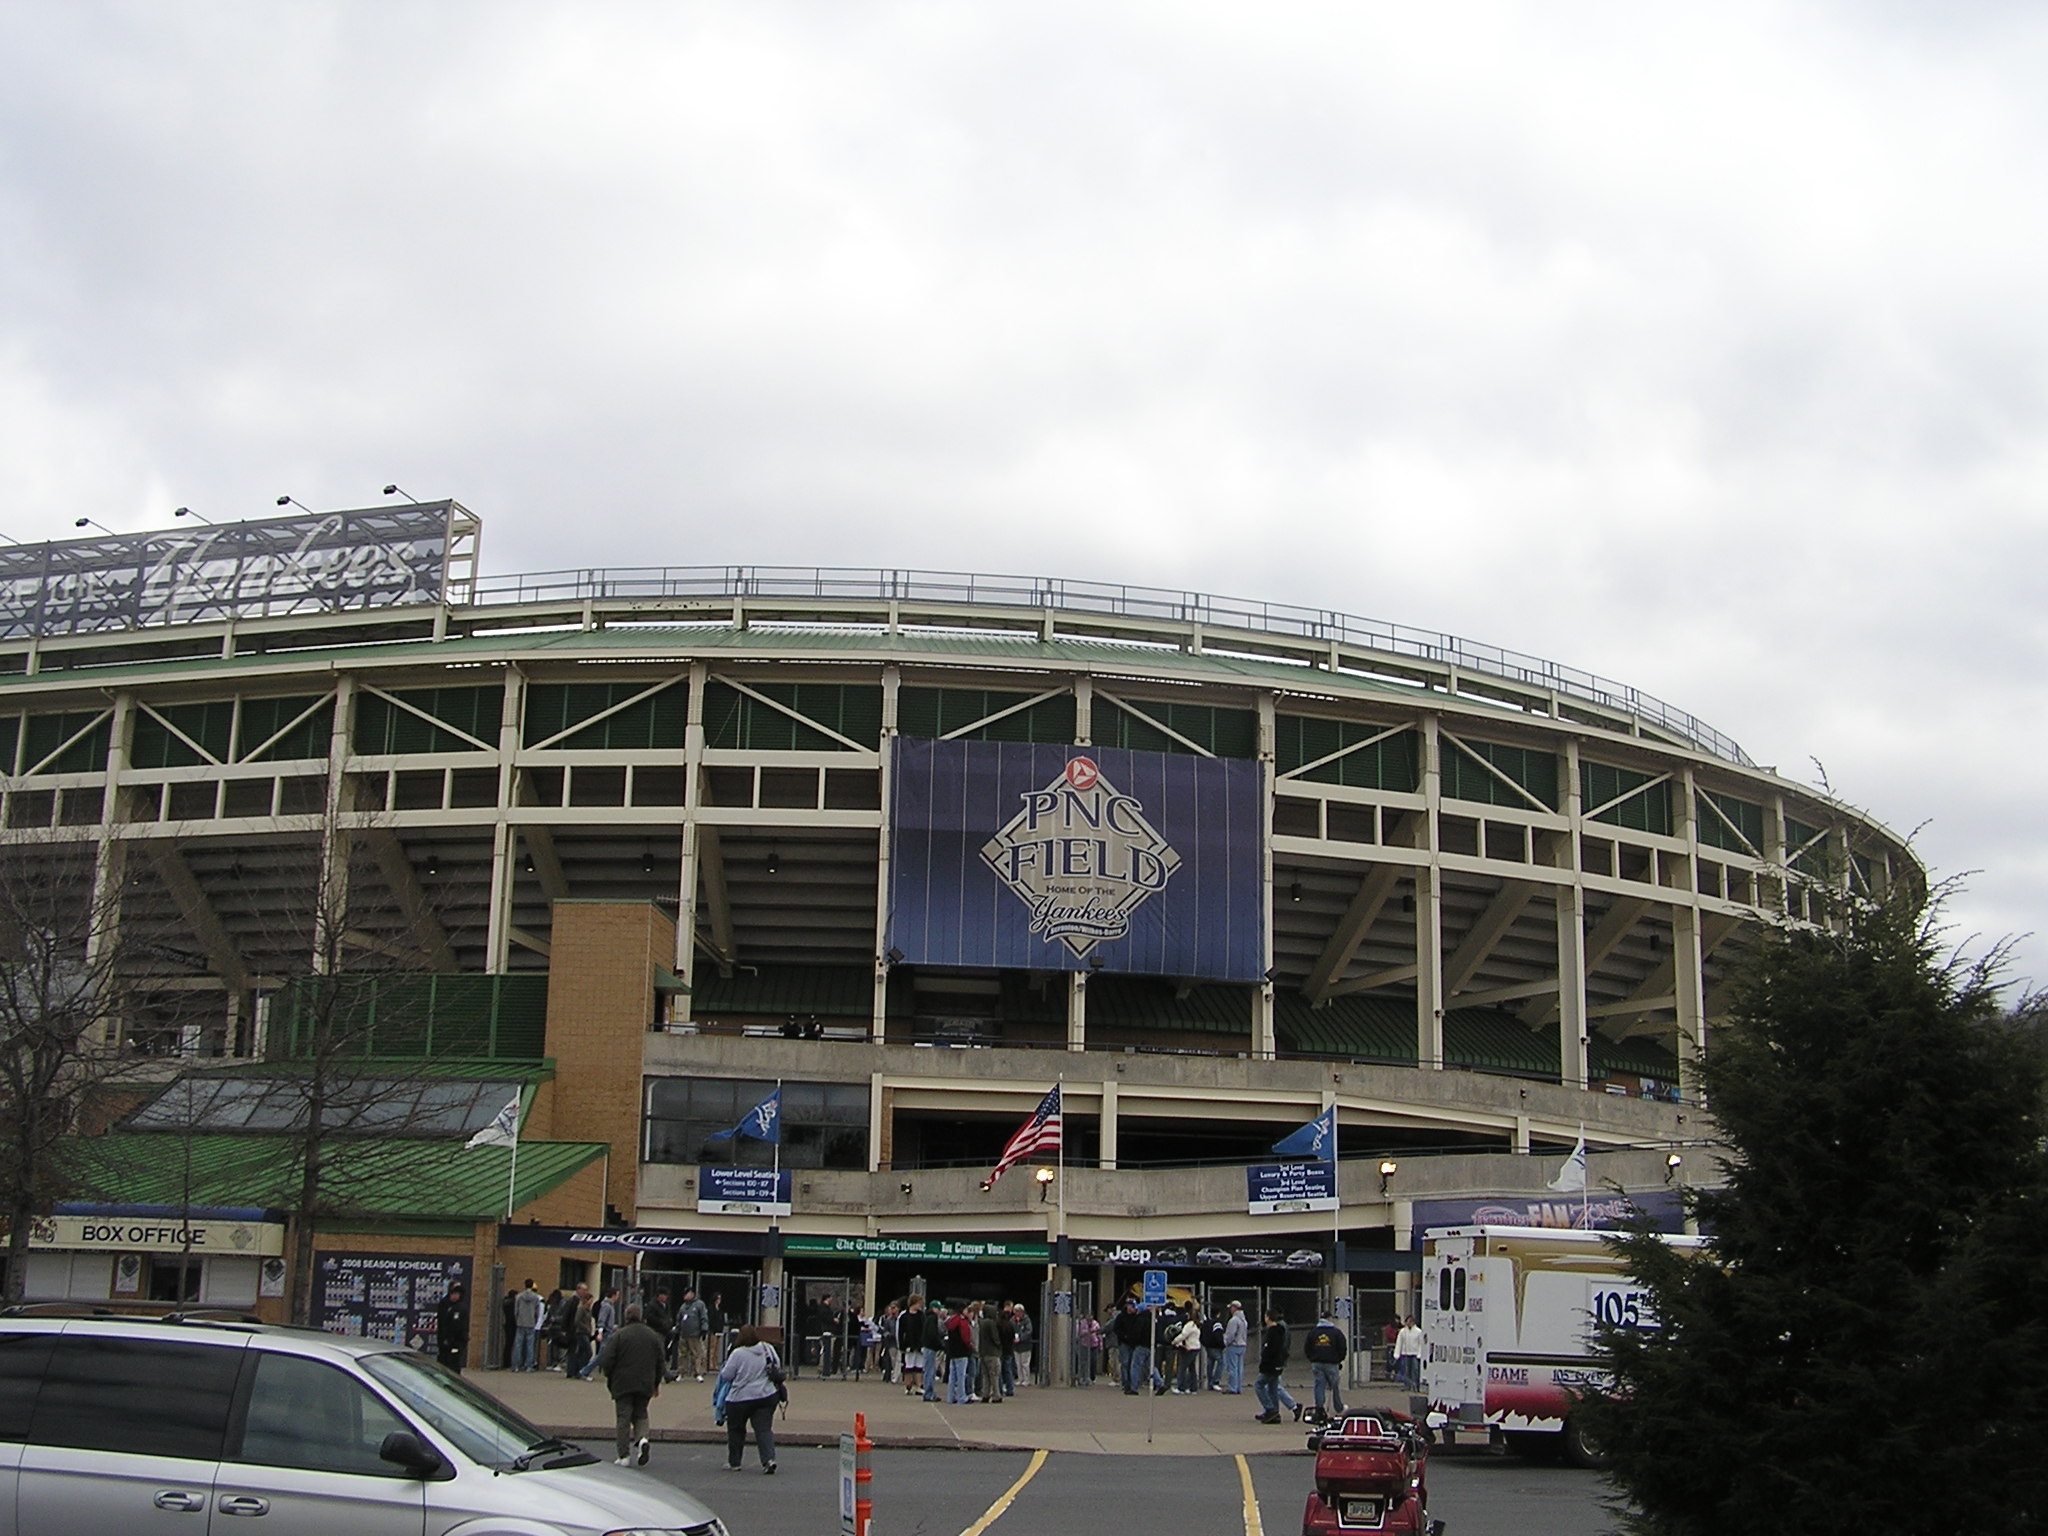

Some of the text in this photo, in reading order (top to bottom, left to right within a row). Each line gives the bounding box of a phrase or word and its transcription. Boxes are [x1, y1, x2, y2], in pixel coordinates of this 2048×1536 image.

[1020, 788, 1143, 838] PNC
[1005, 837, 1169, 891] FIELD
[1095, 886, 1116, 896] THE
[1029, 894, 1128, 933] Yankees
[711, 1168, 780, 1180] Lower Level Seating
[1260, 1171, 1280, 1179] Luxury
[1289, 1170, 1305, 1178] Party
[722, 1179, 746, 1187] Sections
[1291, 1178, 1306, 1186] Level
[722, 1188, 746, 1196] Sections
[1261, 1185, 1290, 1194] Champion
[1304, 1184, 1326, 1192] Seating
[1259, 1193, 1278, 1201] Upper
[1306, 1191, 1328, 1199] Seating
[1527, 1202, 1571, 1229] FAN
[82, 1225, 206, 1245] BOX OFFICE
[570, 1232, 691, 1246] BUD LIGHT
[835, 1238, 855, 1250] The
[855, 1238, 927, 1252] Times-Tribune
[1108, 1244, 1151, 1264] Jeep
[363, 1259, 397, 1270] SEASON
[398, 1260, 443, 1271] SCHEDULE
[1594, 1290, 1639, 1329] 105
[1491, 1367, 1529, 1380] GAME
